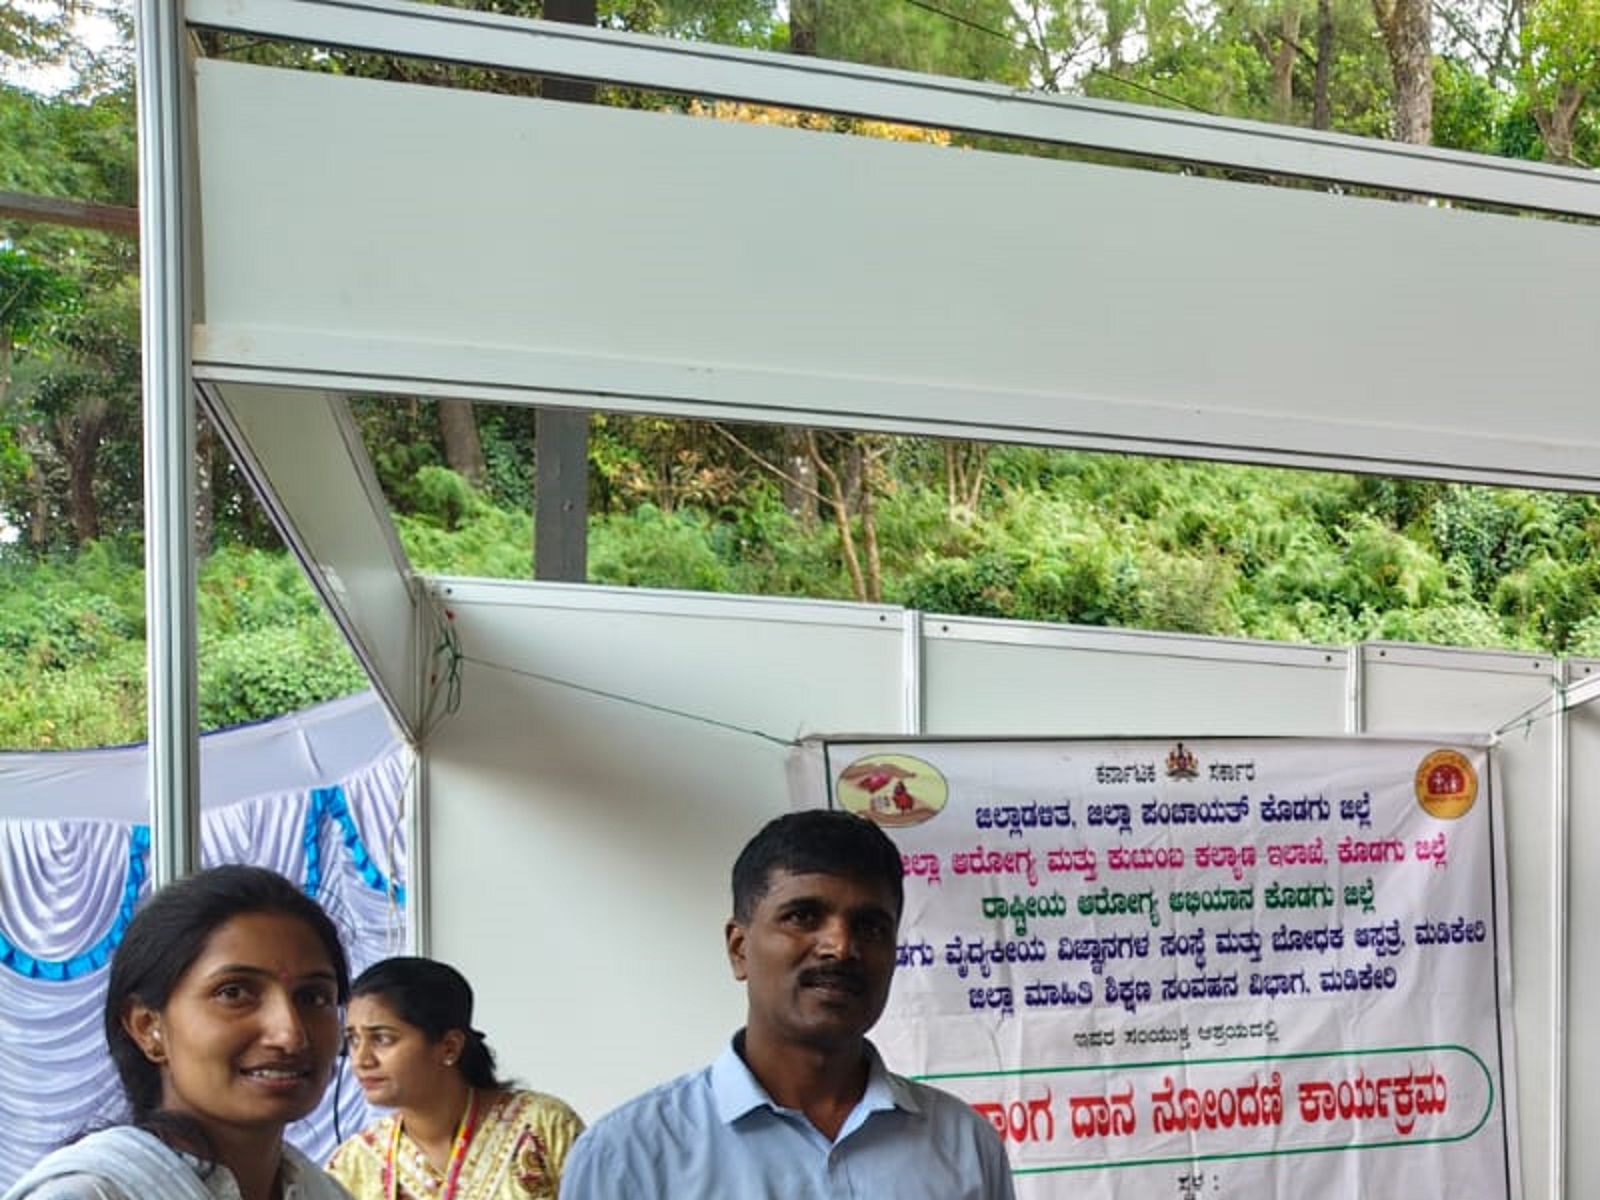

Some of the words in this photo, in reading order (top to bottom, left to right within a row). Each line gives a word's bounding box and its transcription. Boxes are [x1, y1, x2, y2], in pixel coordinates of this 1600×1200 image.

[1088, 803, 1132, 834] ಜಿಲ್ಲಾ
[1141, 796, 1249, 824] ಪಂಚಾಯತ್
[1260, 793, 1330, 821] ಕೊಡಗು
[1340, 791, 1371, 829] ಜಿಲ್ಲೆ
[1047, 847, 1097, 881] ಮತ್ತು
[1108, 845, 1183, 869] ಕುಟುಂಬ
[1195, 843, 1256, 880] ಕಲ್ಯಾಣ
[1338, 836, 1405, 863] ಕೊಡಗು
[1416, 832, 1447, 868] ಜಿಲ್ಲೆ
[1169, 884, 1254, 916] ಅಭಿಯಾನ
[1265, 881, 1334, 909] ಕೊಡಗು
[1344, 878, 1375, 913] ಜಿಲ್ಲೆ
[946, 935, 1046, 978] ವೈದ್ಯಕೀಯ
[1058, 931, 1149, 975] ವಿಜ್ಞಾನಗಳ
[1160, 927, 1206, 969] ಸಂಸ್ಥೆ
[1216, 926, 1262, 962] ಮತ್ತು
[1272, 924, 1344, 953] ಬೋಧಕ
[1415, 916, 1486, 945] ಮಡಿಕೇರಿ
[968, 986, 1014, 1015] ಜಿಲ್ಲಾ
[1025, 978, 1093, 1007] ಮಾಹಿತಿ
[1106, 976, 1151, 1013] ಶಿಕ್ಷಣ
[1162, 973, 1238, 1001] ಸಂವಹನ
[1320, 963, 1397, 993] ಮಡಿಕೇರಿ
[1124, 1024, 1191, 1050] ಸಂಯುಕ್ತ
[1198, 1019, 1279, 1046] ಆಶ್ರಯದಲ್ಲಿ
[1070, 1080, 1137, 1138] ದಾನ
[1152, 1072, 1283, 1133] ನೋಂದಣಿ
[1299, 1060, 1447, 1134] ಕಾರ್ಯಕ್ರಮ
